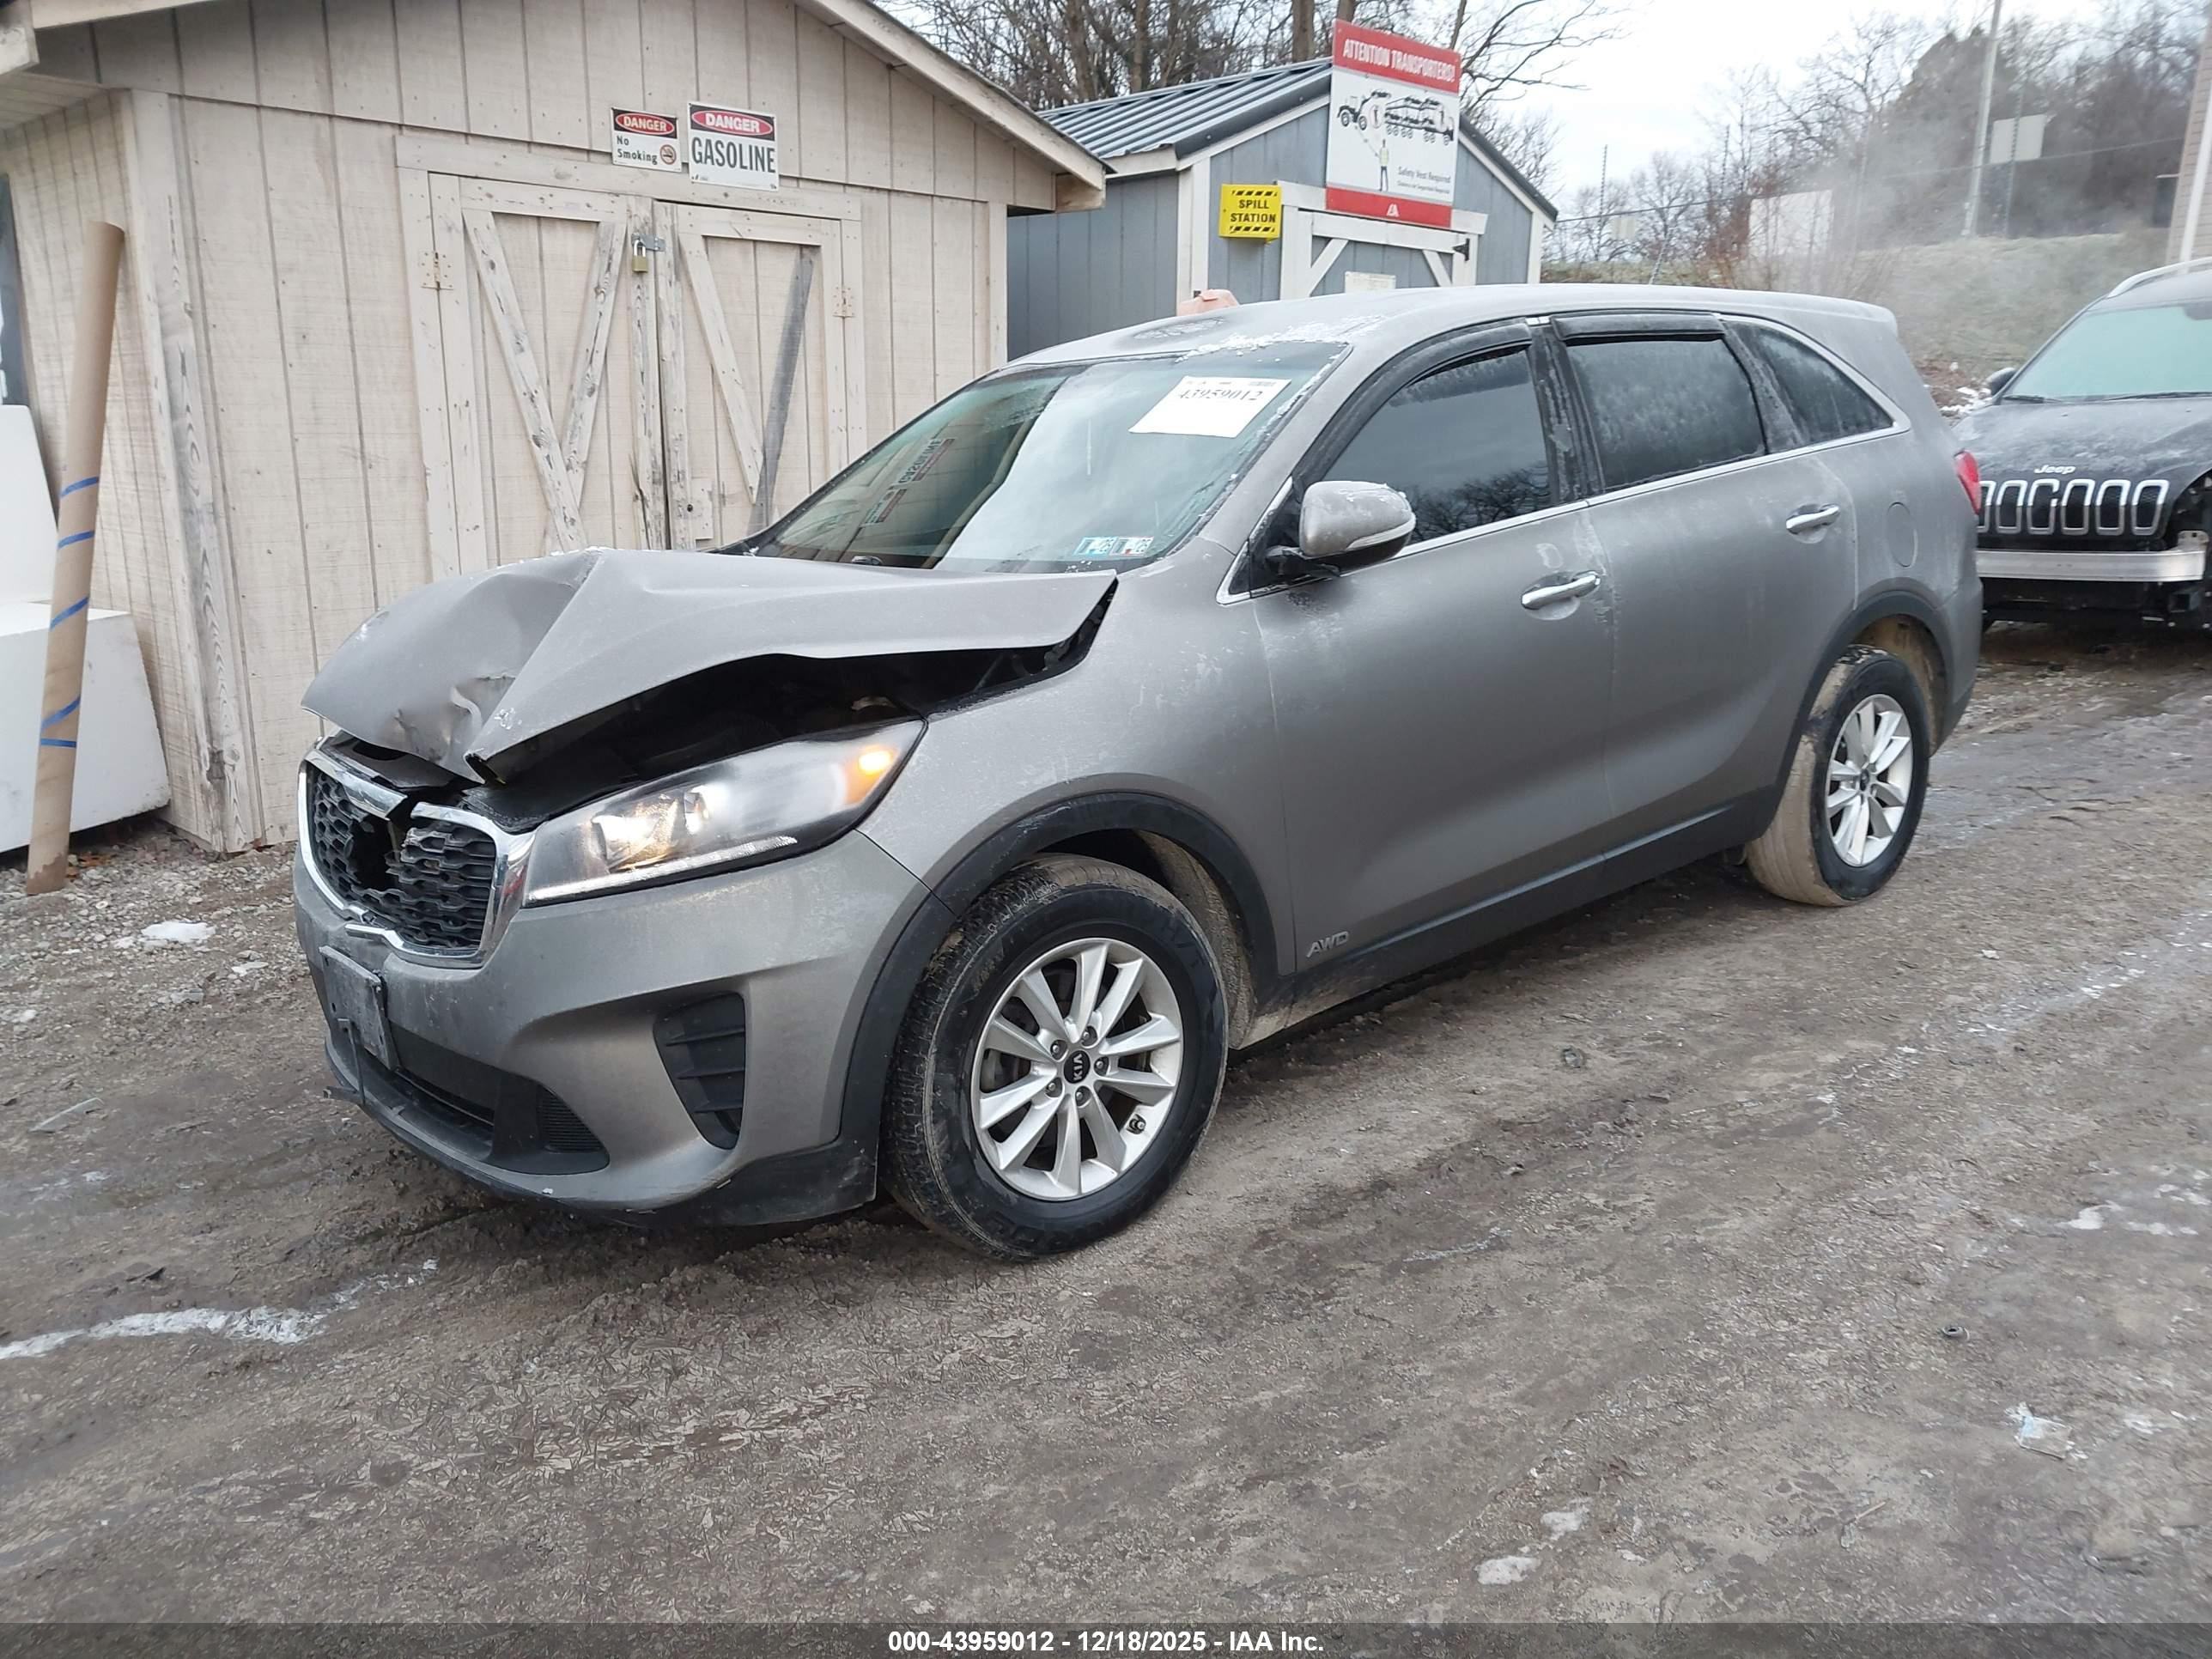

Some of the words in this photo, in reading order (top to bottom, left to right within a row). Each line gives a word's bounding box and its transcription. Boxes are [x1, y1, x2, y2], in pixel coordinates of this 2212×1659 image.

[1342, 38, 1391, 68] ATTENTION
[623, 116, 667, 132] DANGER
[705, 112, 760, 133] DANGER
[616, 135, 629, 146] No
[617, 148, 659, 166] Smoking
[691, 137, 776, 173] GASOLINE
[1238, 199, 1270, 210] SPILL
[1230, 212, 1277, 223] STATION
[2033, 464, 2076, 475] Jeep
[1306, 931, 1349, 958] AWD
[1073, 1053, 1084, 1081] KIA
